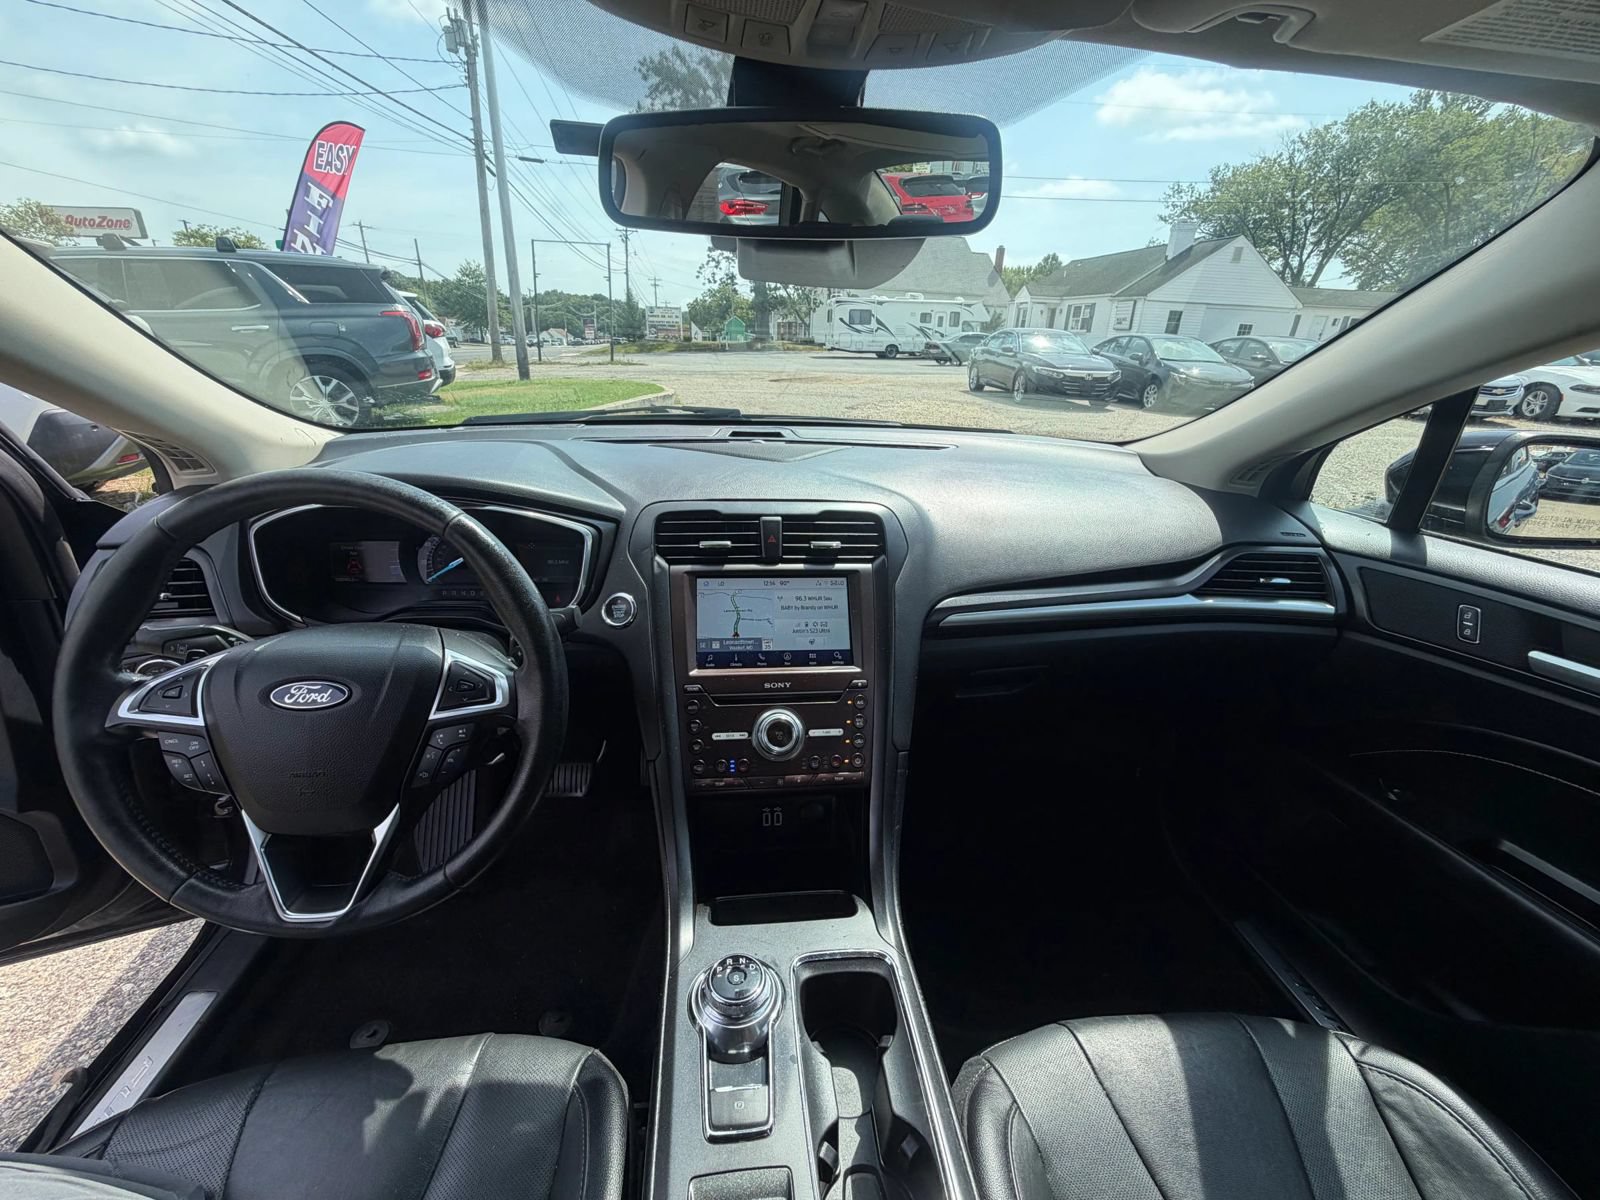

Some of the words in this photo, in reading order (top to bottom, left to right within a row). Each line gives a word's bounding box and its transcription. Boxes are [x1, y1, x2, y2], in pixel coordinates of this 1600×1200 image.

[313, 140, 356, 175] EASY
[65, 214, 132, 229] AutoZone
[284, 685, 333, 703] Ford
[716, 966, 723, 974] P
[733, 974, 740, 982] S
